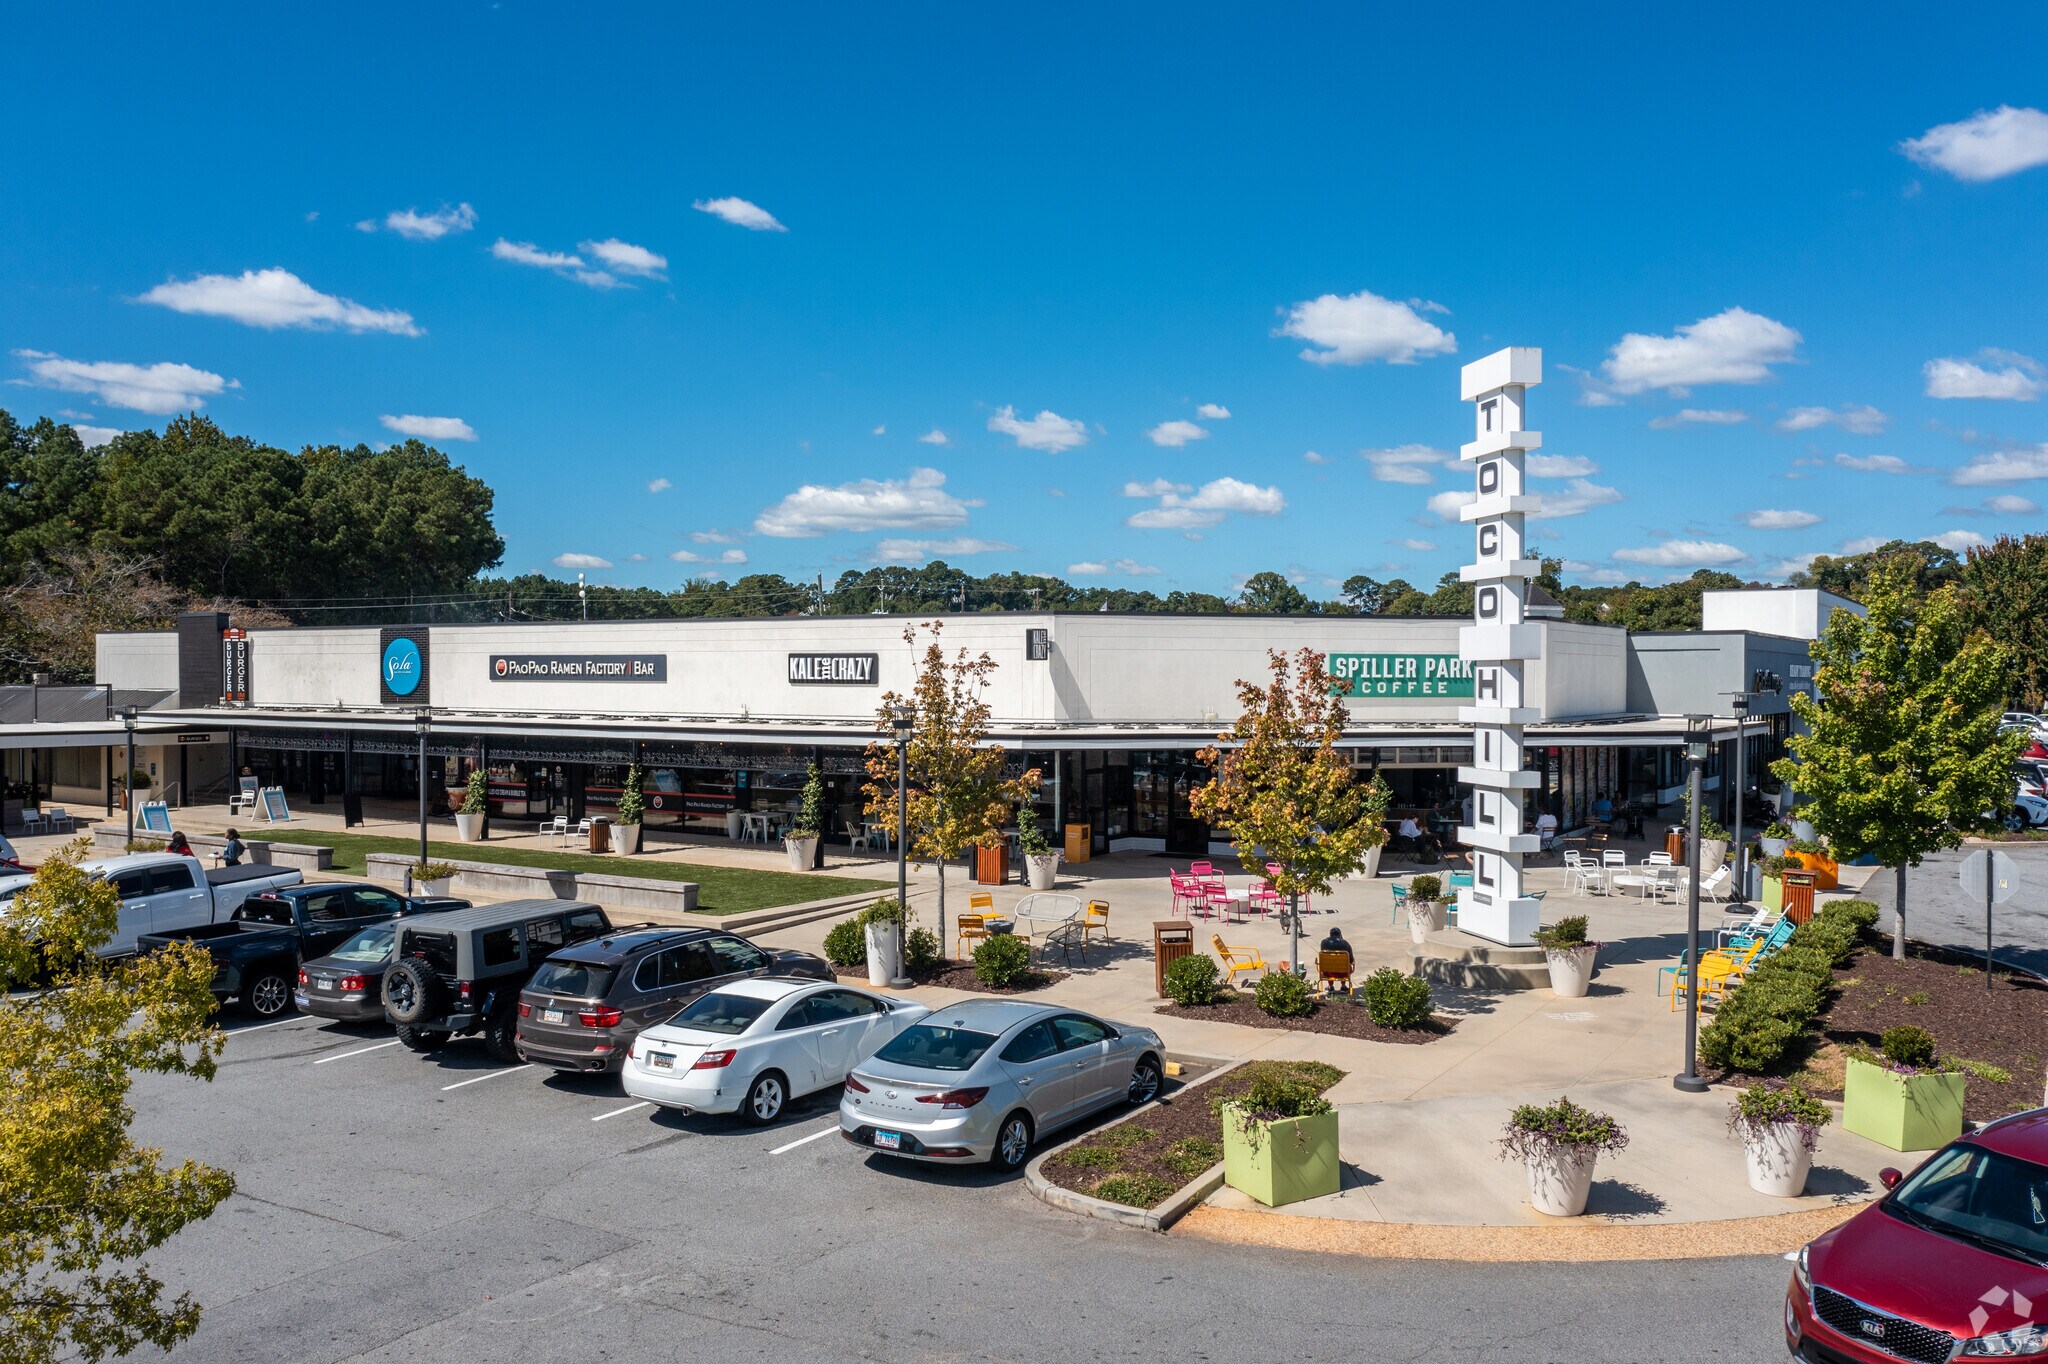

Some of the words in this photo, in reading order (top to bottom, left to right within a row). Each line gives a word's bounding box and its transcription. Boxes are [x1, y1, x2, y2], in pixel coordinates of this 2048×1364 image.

[1479, 398, 1498, 619] TOCO
[237, 642, 245, 692] BURGER
[386, 651, 417, 681] Sola
[790, 657, 822, 680] KALE
[821, 657, 831, 680] me
[831, 657, 873, 680] CRAZY
[1336, 657, 1417, 678] SPILLER
[1425, 657, 1473, 678] PARK
[1361, 681, 1448, 694] COFFEE
[1478, 668, 1498, 888] HILL
[1863, 1321, 1881, 1335] KIA
